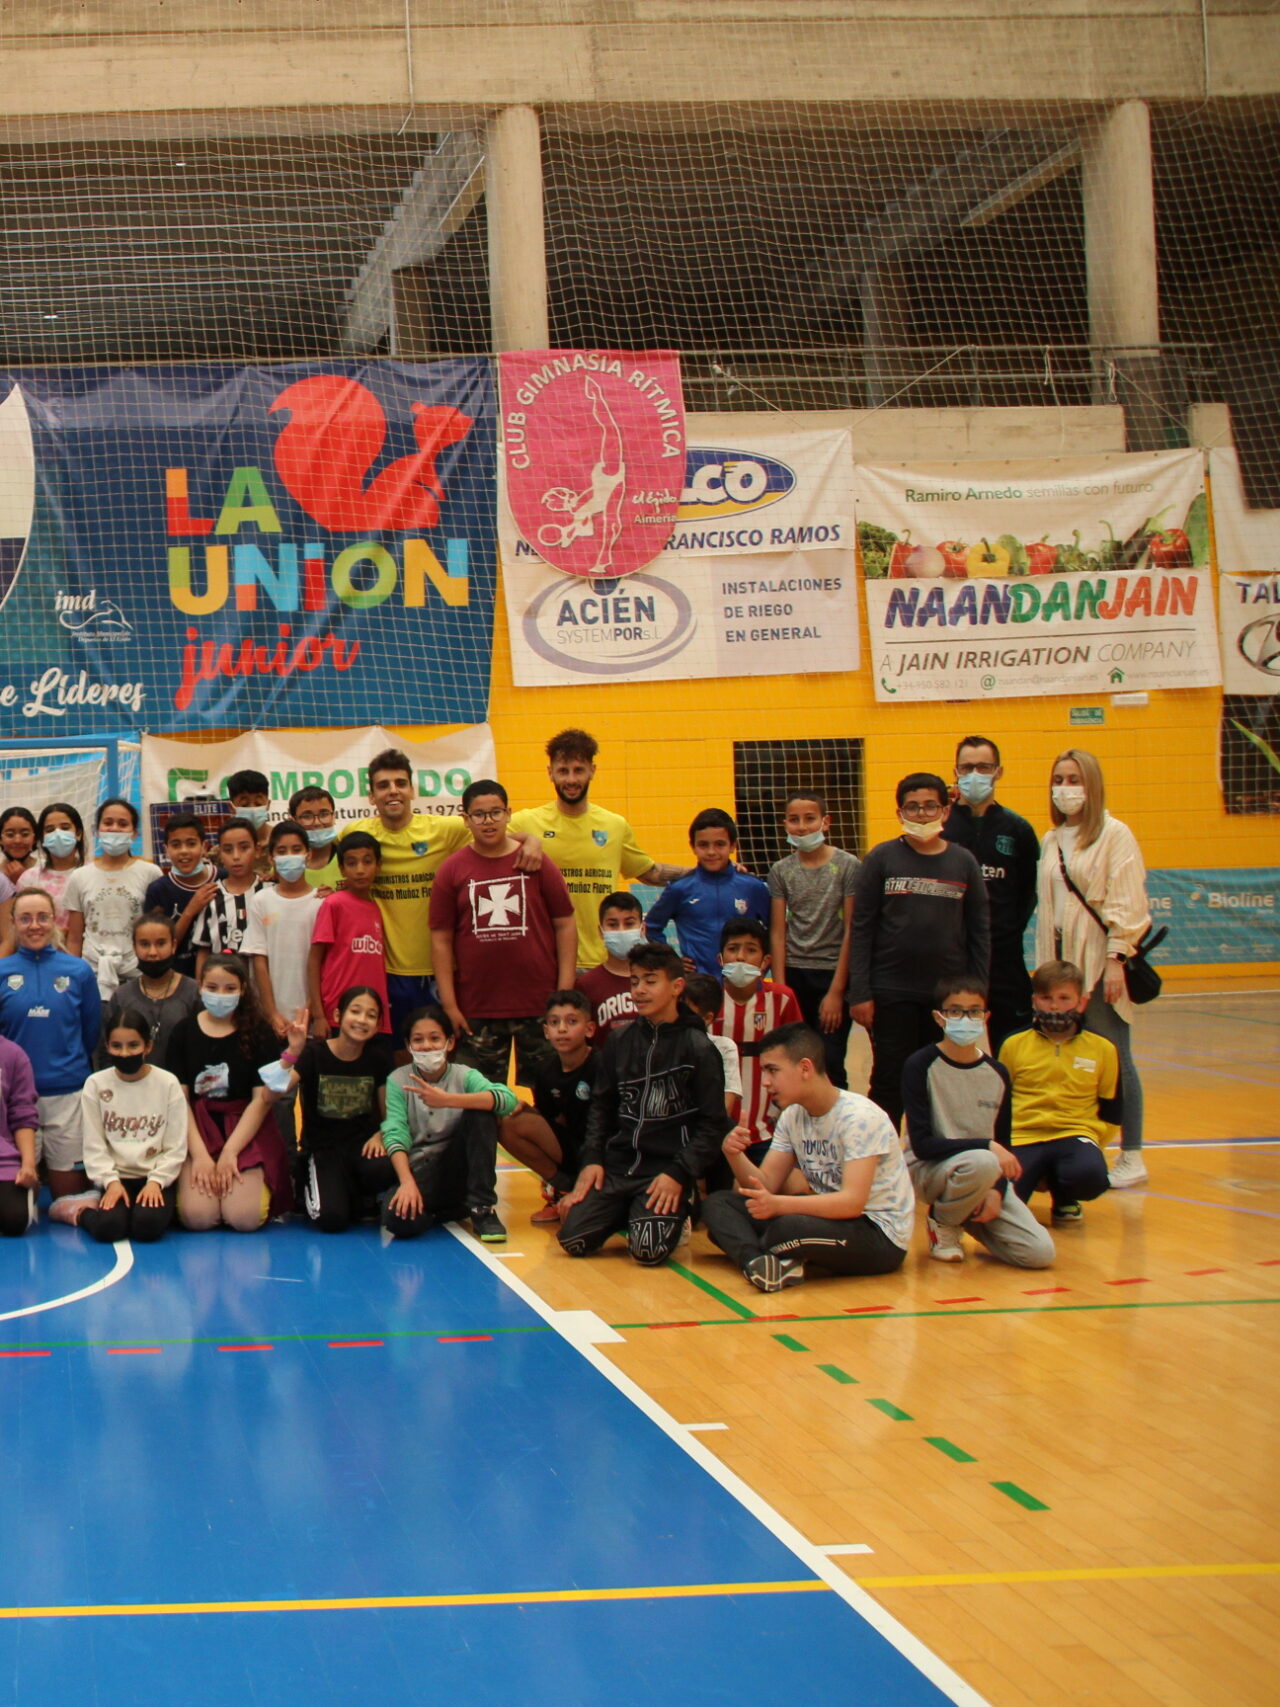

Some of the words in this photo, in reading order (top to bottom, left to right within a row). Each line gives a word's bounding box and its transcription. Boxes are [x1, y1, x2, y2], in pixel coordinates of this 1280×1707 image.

[515, 352, 624, 407] GIMNASIA
[626, 369, 683, 459] RÍTMICA
[506, 410, 532, 470] CLUB
[165, 466, 283, 537] LA
[904, 488, 963, 503] Ramiro
[964, 486, 1024, 502] Arnedo
[1026, 483, 1080, 499] semillas
[1083, 484, 1110, 497] con
[1112, 480, 1155, 495] futuro
[769, 524, 841, 545] RAMOS
[54, 589, 97, 611] imd
[721, 578, 843, 596] INSTALACIONES
[883, 575, 1199, 629] NAANDANJAIN
[556, 587, 657, 627] ACIÉN
[724, 605, 745, 619] DE
[747, 603, 794, 618] RIEGO
[725, 630, 747, 643] EN
[749, 626, 822, 642] GENERAL
[174, 623, 361, 711] junior
[879, 653, 894, 672] A
[895, 650, 950, 677] JAIN
[955, 644, 1092, 670] IRRIGATION
[1096, 639, 1198, 663] COMPANY
[21, 665, 148, 718] Líderes
[335, 806, 371, 820] uturo
[1207, 891, 1275, 909] Bioline
[222, 925, 244, 945] Je
[597, 992, 638, 1028] ORIG
[102, 1110, 166, 1138] Happy
